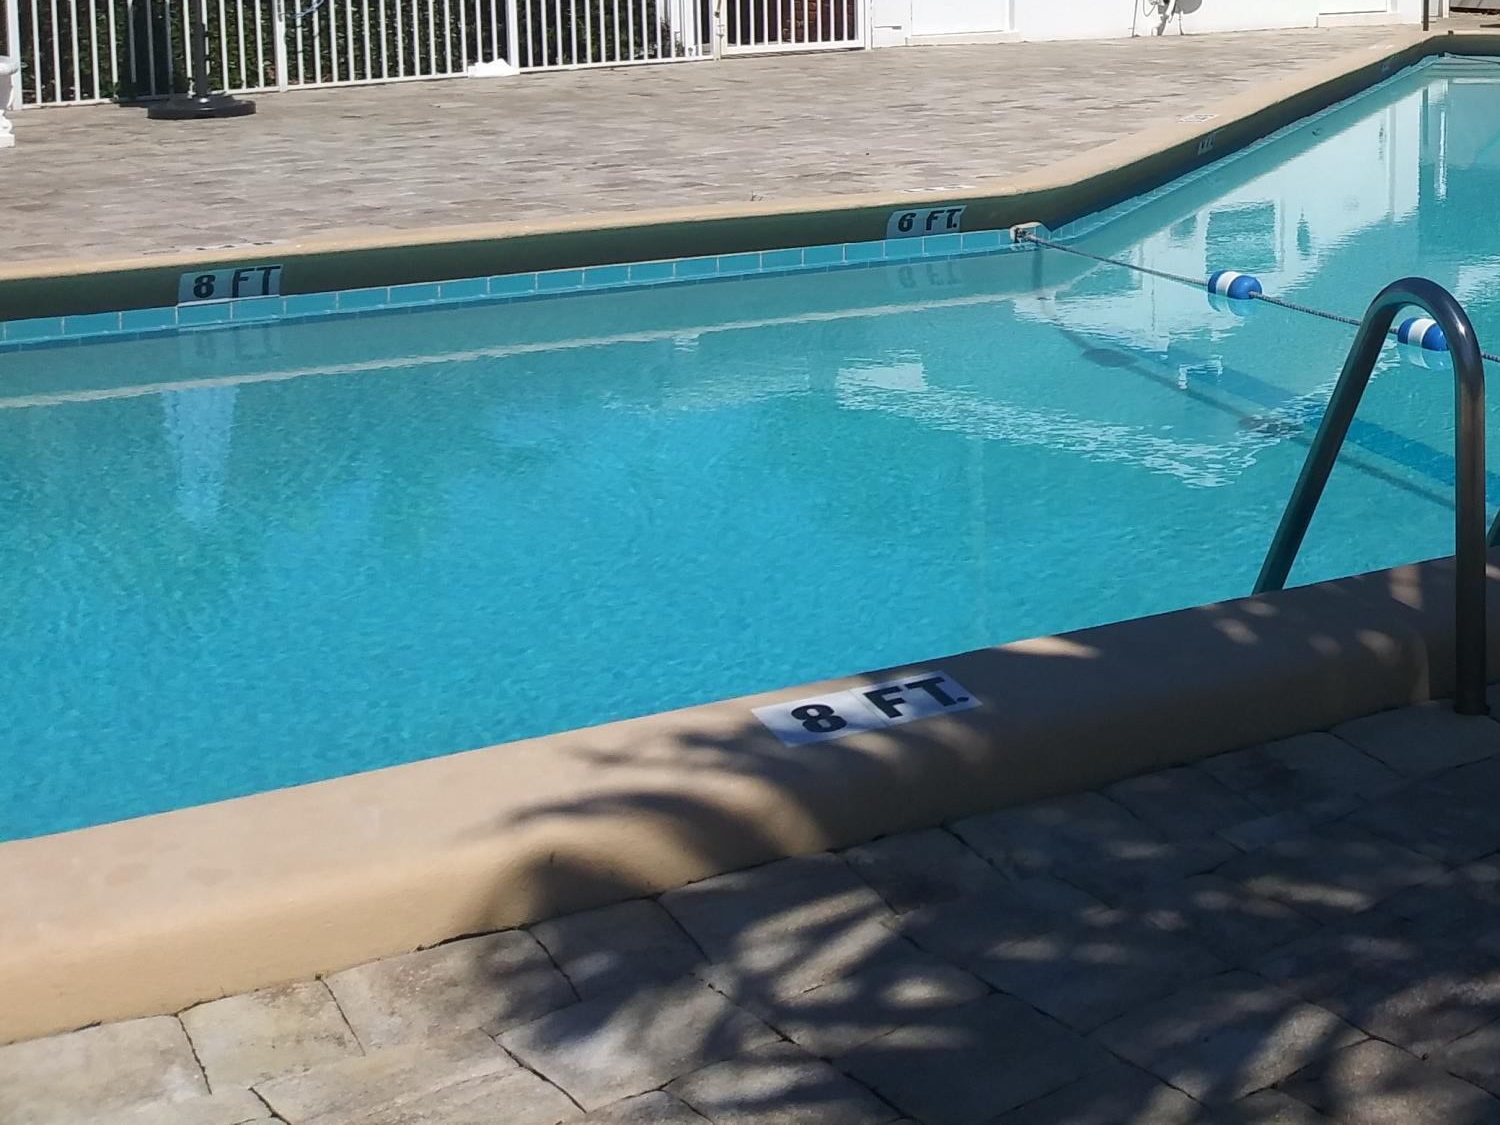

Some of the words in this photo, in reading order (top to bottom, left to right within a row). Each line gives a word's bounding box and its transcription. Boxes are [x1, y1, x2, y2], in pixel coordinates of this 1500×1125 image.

[898, 212, 917, 233] 6
[925, 208, 963, 231] FT.
[193, 274, 216, 298] 8
[231, 265, 282, 299] FT
[790, 703, 848, 733] 8
[863, 676, 970, 719] FT.
